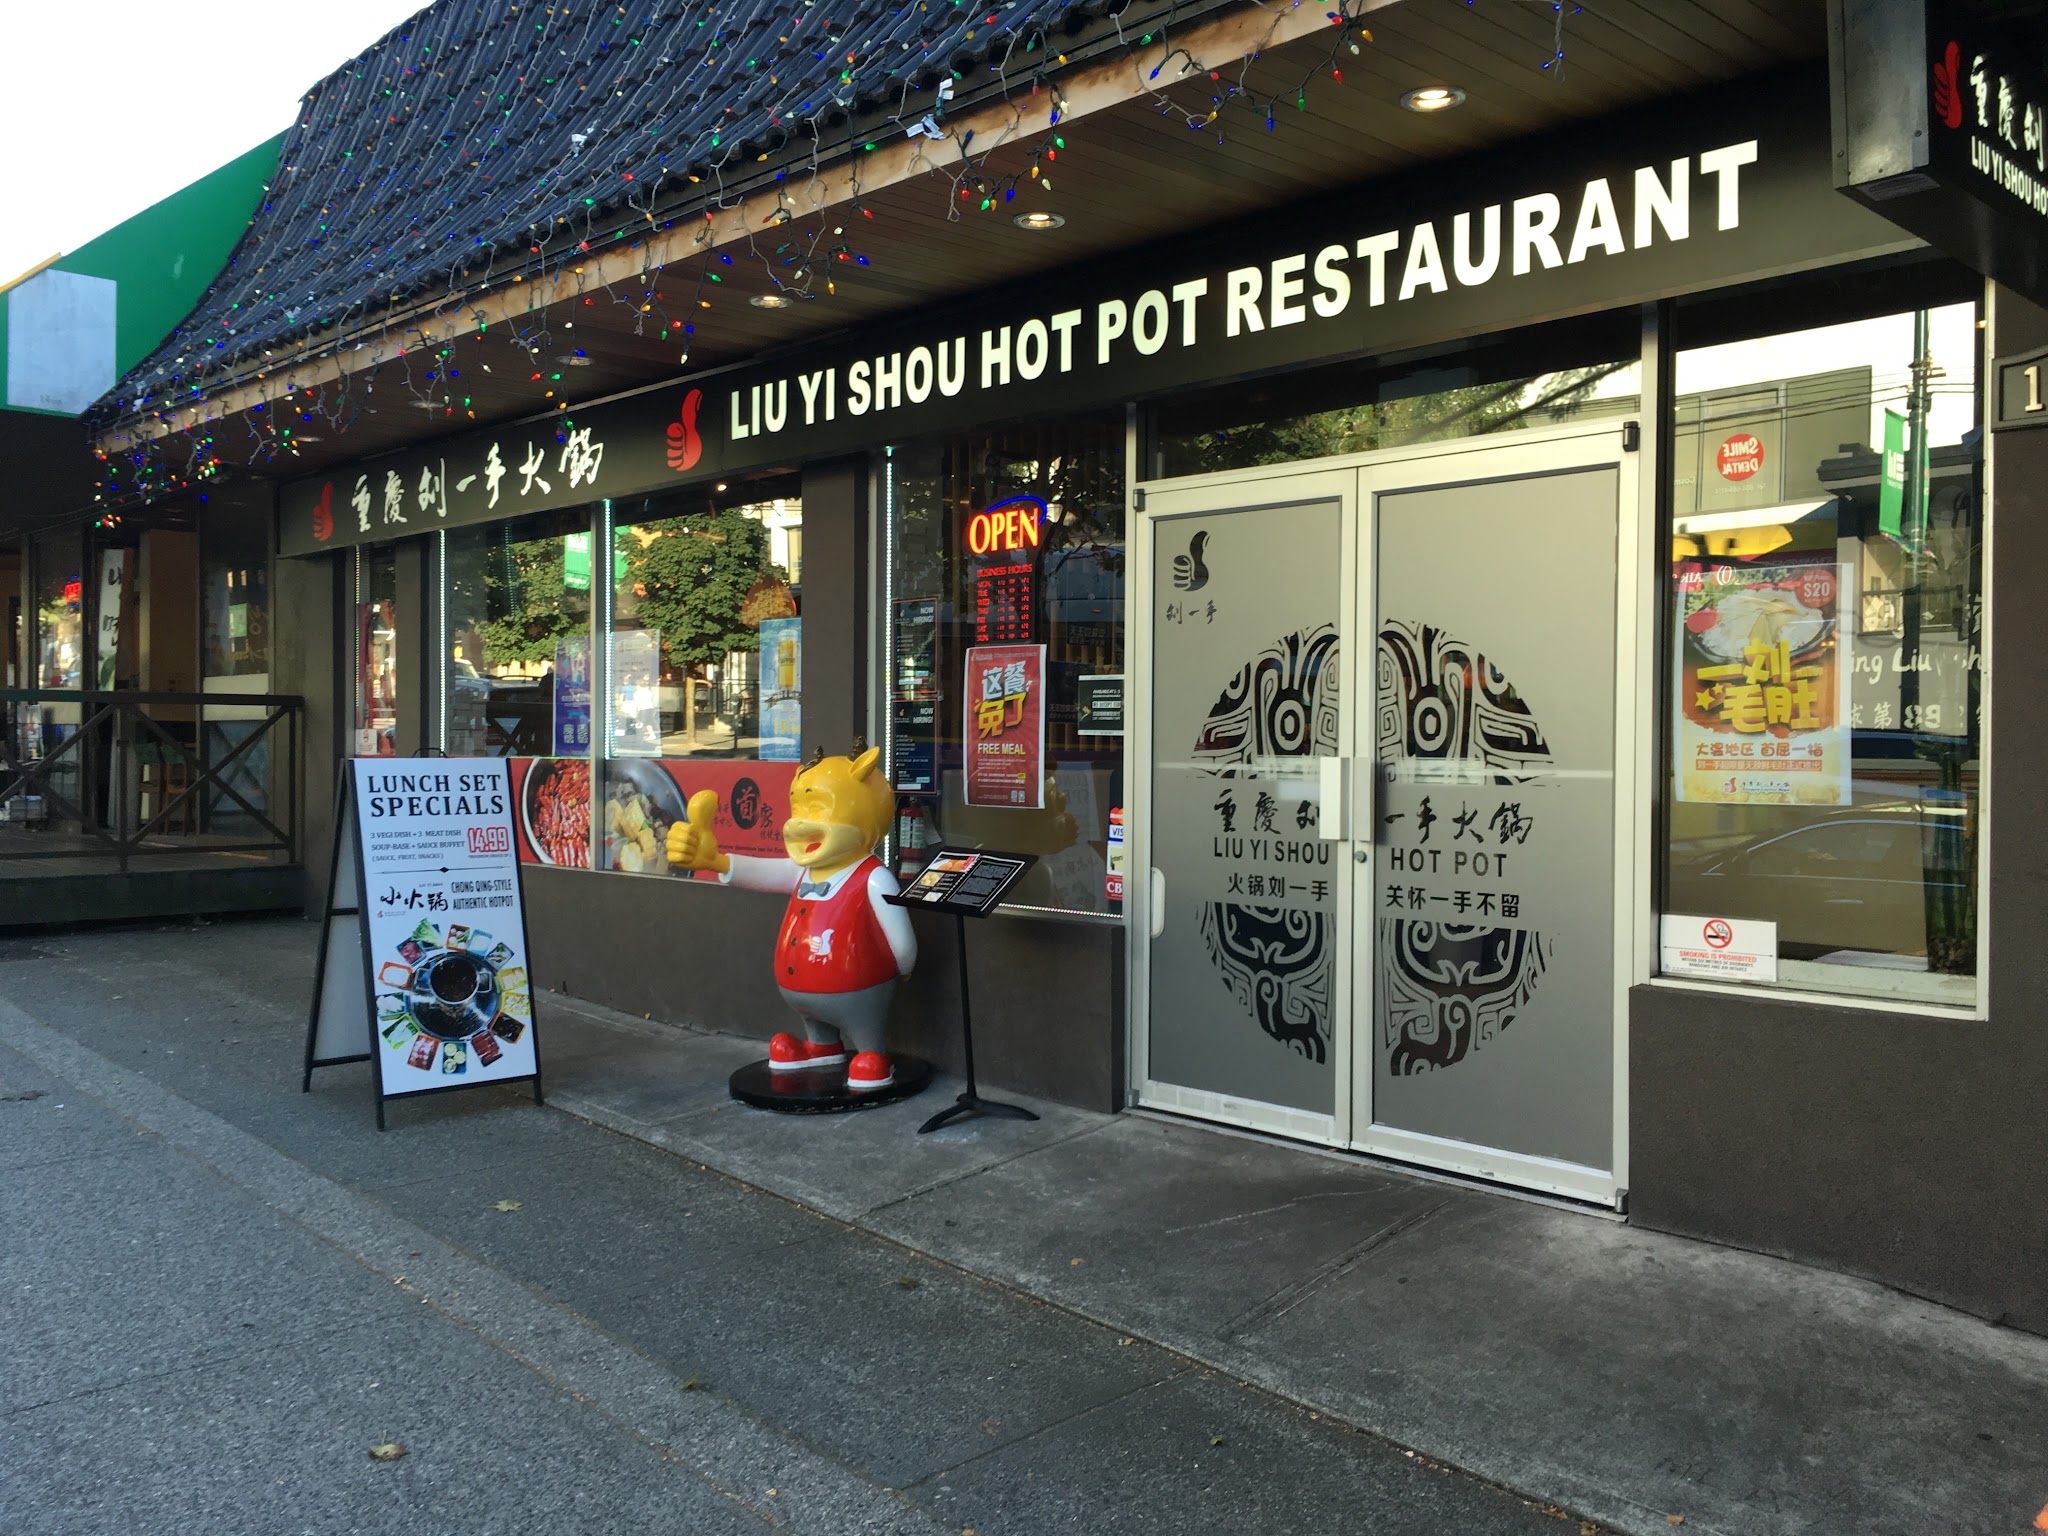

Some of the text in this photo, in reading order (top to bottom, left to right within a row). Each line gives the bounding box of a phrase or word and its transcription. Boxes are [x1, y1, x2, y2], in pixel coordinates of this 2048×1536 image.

[1971, 135, 2048, 217] LIU YI SHOU HO
[731, 139, 1758, 440] LIU YI SHOU HOT POT RESTAURANT
[968, 507, 1039, 555] OPEN
[977, 564, 1033, 577] BUSINESS HOURS
[1803, 582, 1830, 597] $20
[981, 660, 1027, 701] 这餐
[920, 707, 934, 715] NOW
[975, 691, 1027, 739] 免了
[1719, 679, 1821, 734] 毛肚
[977, 743, 1026, 755] FREE MEAL
[368, 774, 501, 793] LUNCH SET
[370, 795, 504, 817] SPECIALS
[376, 831, 394, 839] VEGI
[467, 825, 510, 853] 14.99
[371, 842, 411, 851] SOUP-BASE
[417, 841, 439, 849] SAUCE
[440, 840, 466, 849] BUFFET
[1214, 836, 1508, 878] LIU YI SHOU HOT POT
[451, 881, 474, 893] CHONG
[1228, 872, 1520, 919] 火锅刘一手 关怀一手不留
[453, 895, 514, 910] AUTHENTIC HOTPOT
[1679, 950, 1709, 959] SMOKING
[1718, 953, 1757, 963] PROHIBITED
